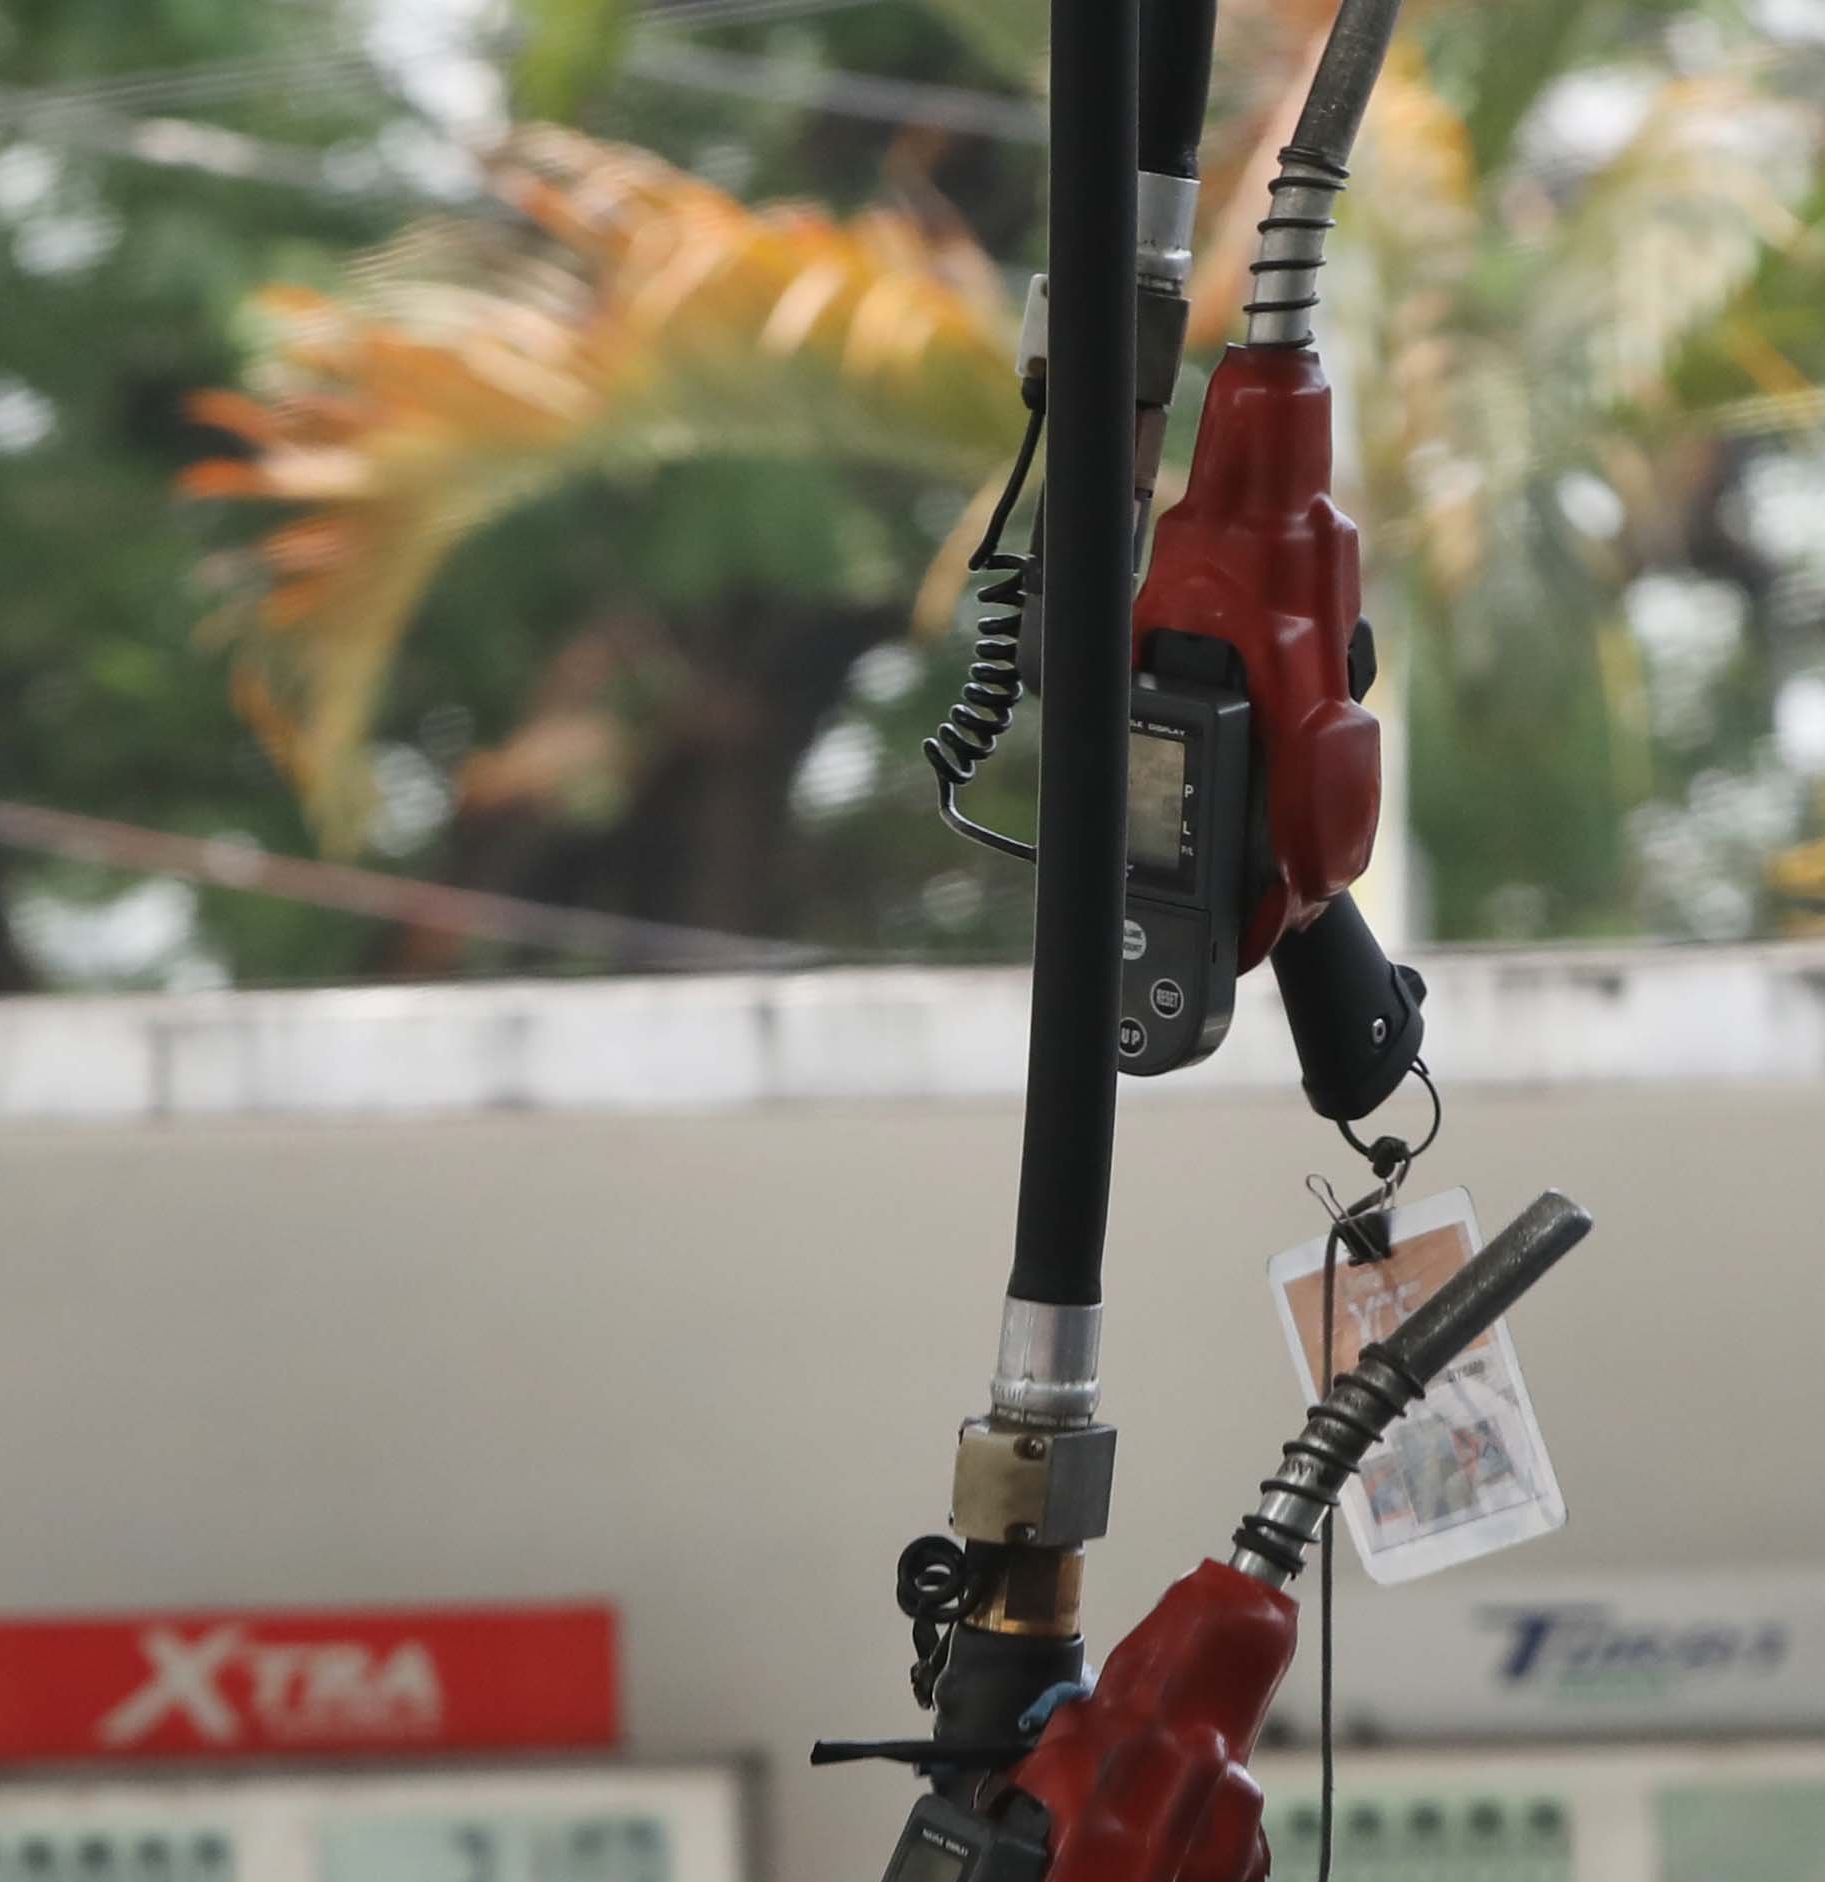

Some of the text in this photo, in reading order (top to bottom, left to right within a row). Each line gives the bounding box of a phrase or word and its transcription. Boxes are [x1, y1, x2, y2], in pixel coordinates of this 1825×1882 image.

[1183, 783, 1195, 799] P
[1181, 820, 1192, 836] L
[1120, 1026, 1142, 1046] UP
[90, 1622, 445, 1750] XTRA
